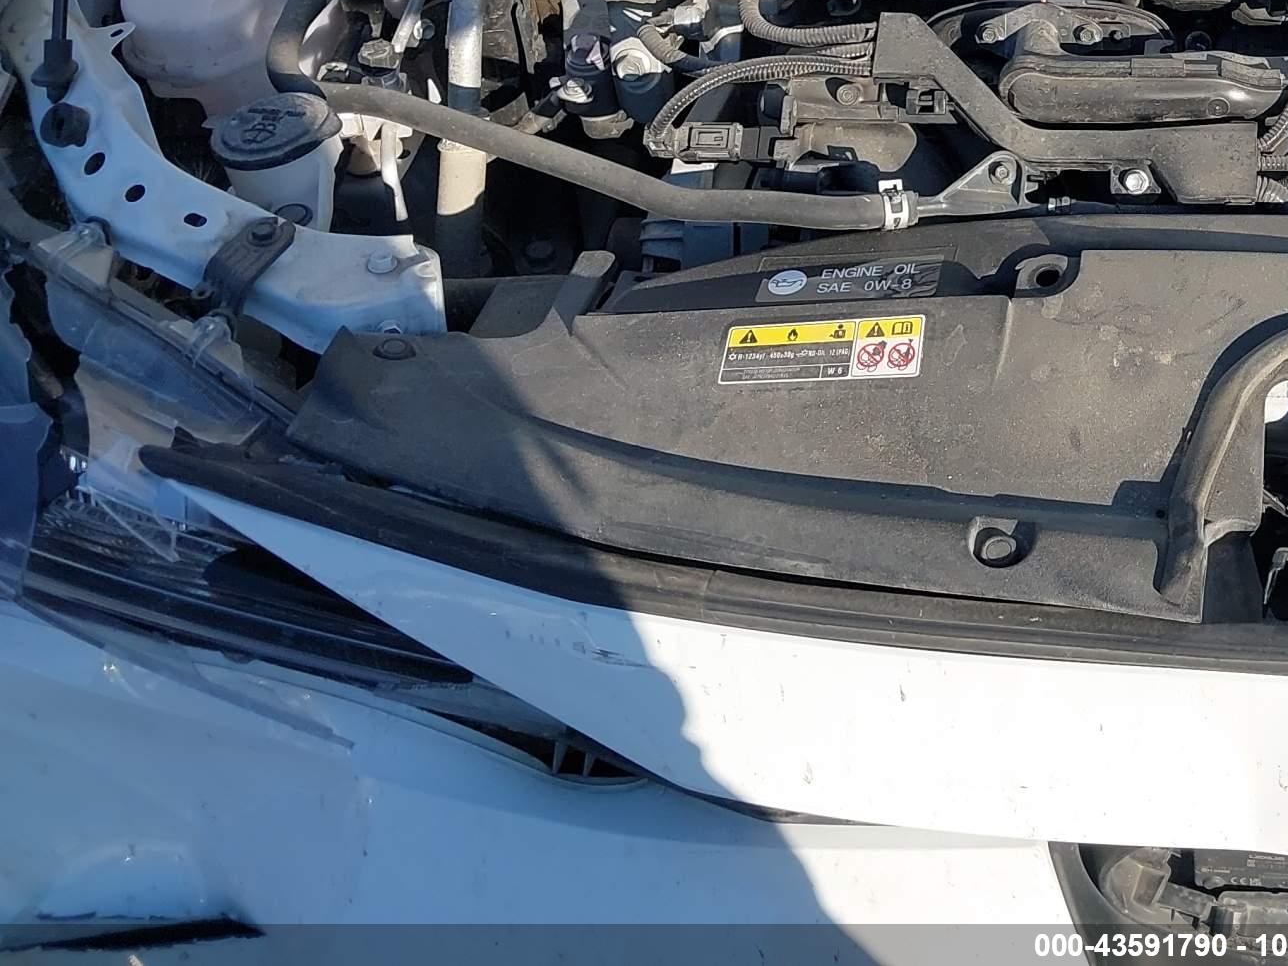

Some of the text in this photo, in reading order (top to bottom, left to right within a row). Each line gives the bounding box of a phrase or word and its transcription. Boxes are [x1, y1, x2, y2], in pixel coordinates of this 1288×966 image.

[821, 263, 921, 279] ENGINE OIL
[816, 278, 912, 294] SAE 0W-8
[827, 367, 836, 375] W
